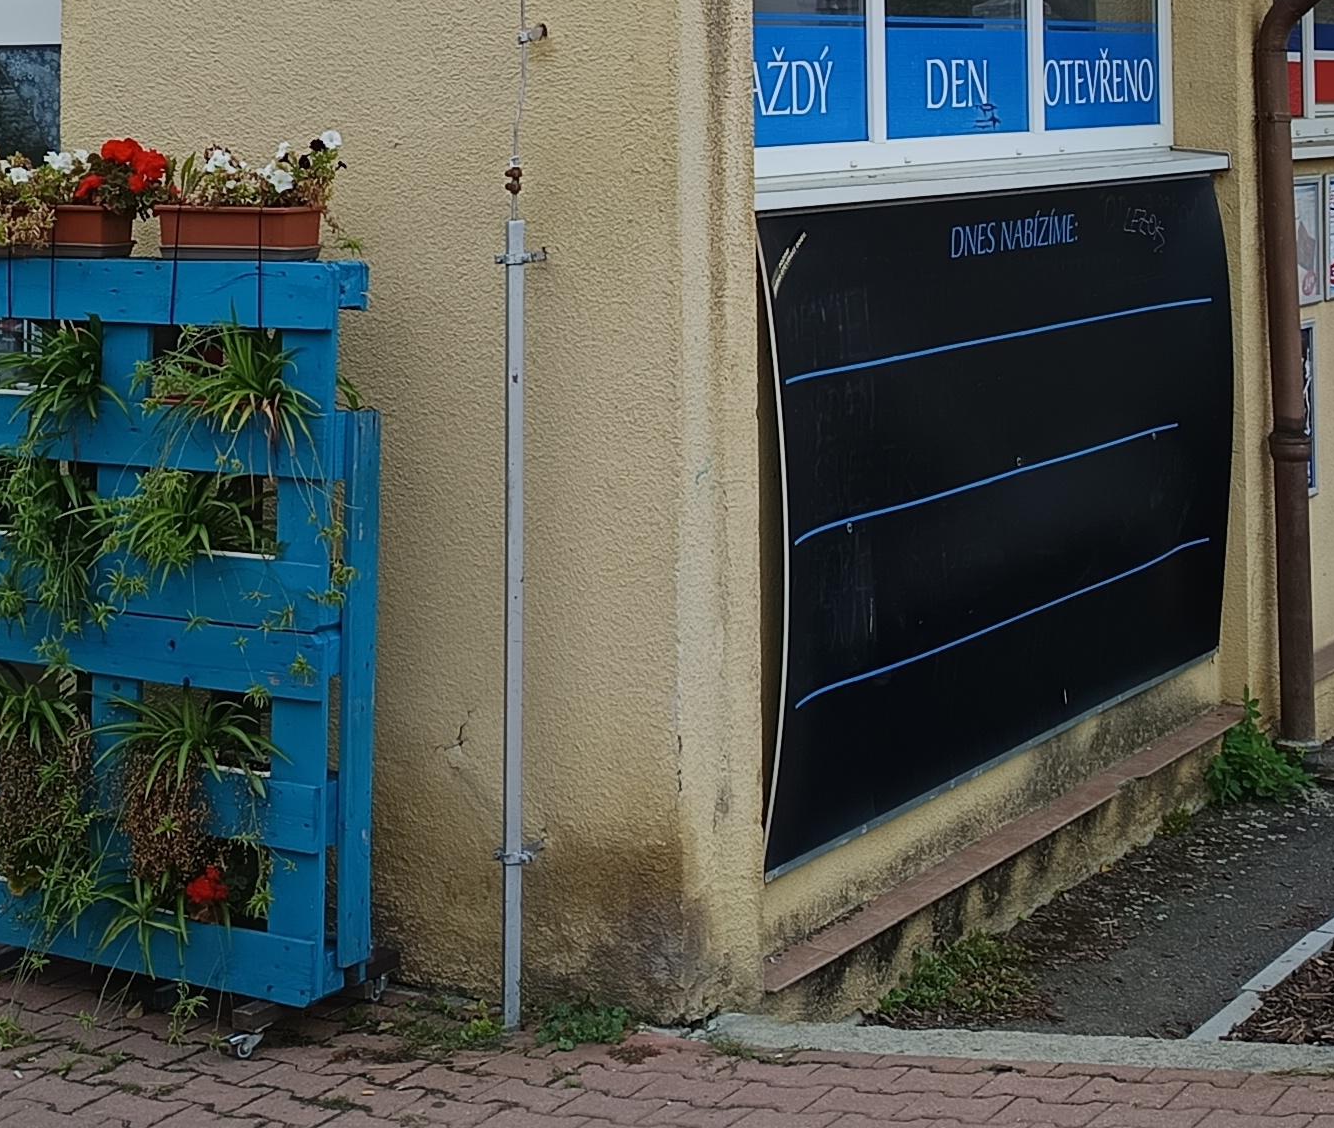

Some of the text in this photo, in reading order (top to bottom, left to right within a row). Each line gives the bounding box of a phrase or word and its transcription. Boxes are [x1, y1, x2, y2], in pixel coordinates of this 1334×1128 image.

[753, 46, 1154, 116] AŽDÝ DEN OTEVŘENO
[951, 208, 1078, 258] DNES NABÍZÍME:
